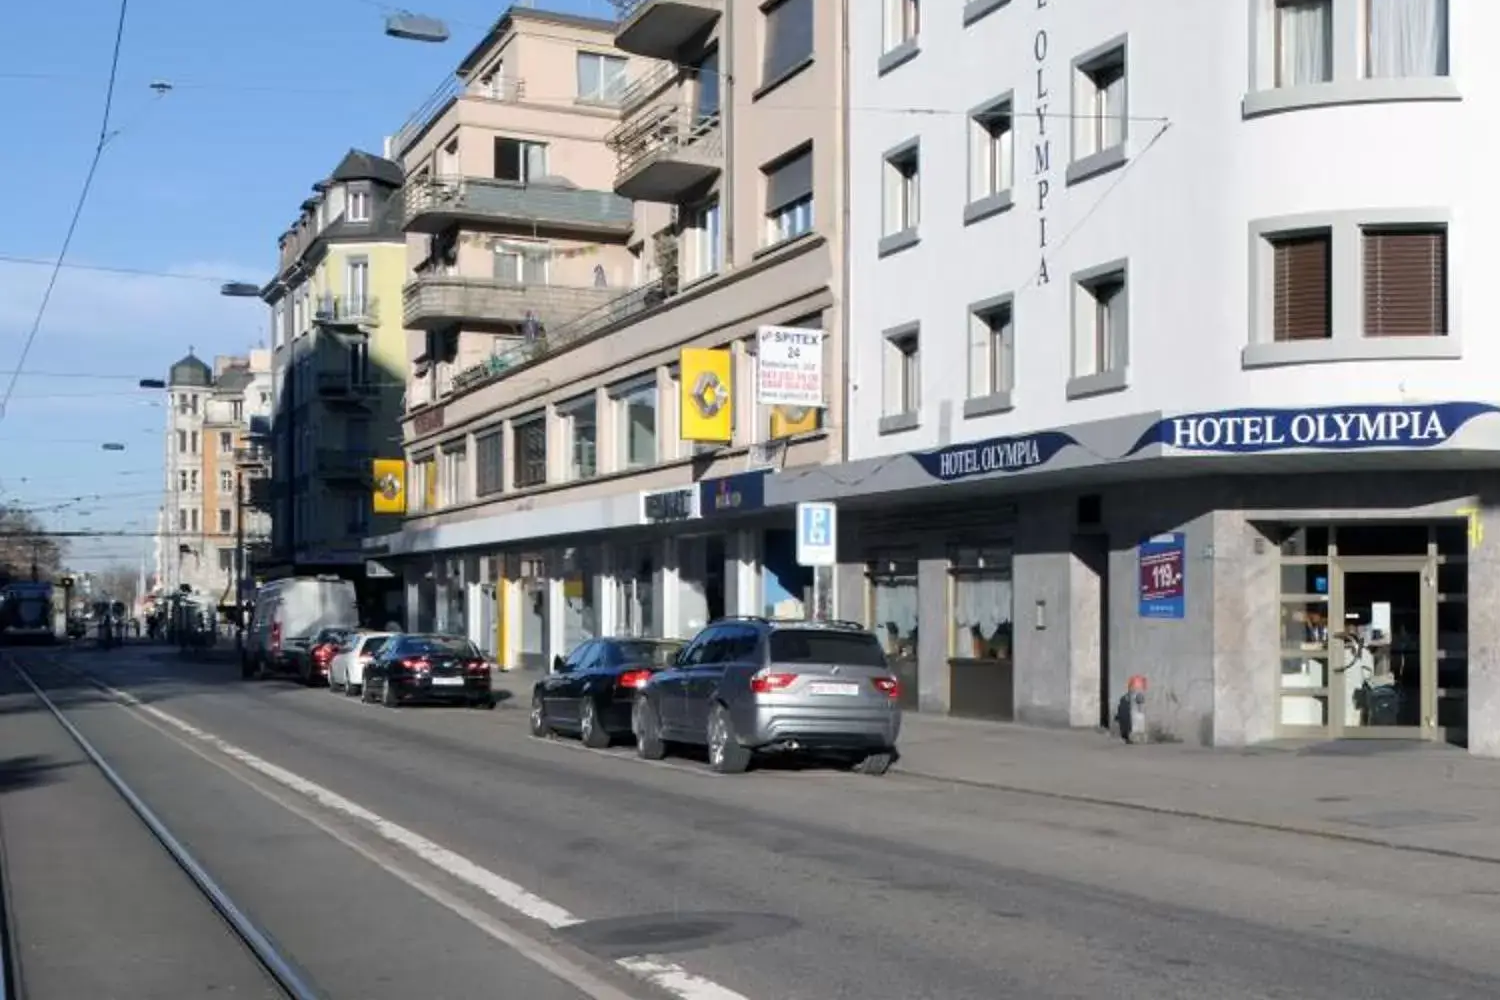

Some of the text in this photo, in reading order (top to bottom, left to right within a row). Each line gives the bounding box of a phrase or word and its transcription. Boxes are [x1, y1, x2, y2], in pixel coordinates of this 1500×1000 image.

[1034, 30, 1050, 286] OLYMPIA
[775, 331, 819, 345] SPITEX
[787, 346, 801, 359] 24
[1173, 410, 1448, 446] HOTEL OLYMPIA
[940, 440, 1040, 476] HOTEL OLYMPIA
